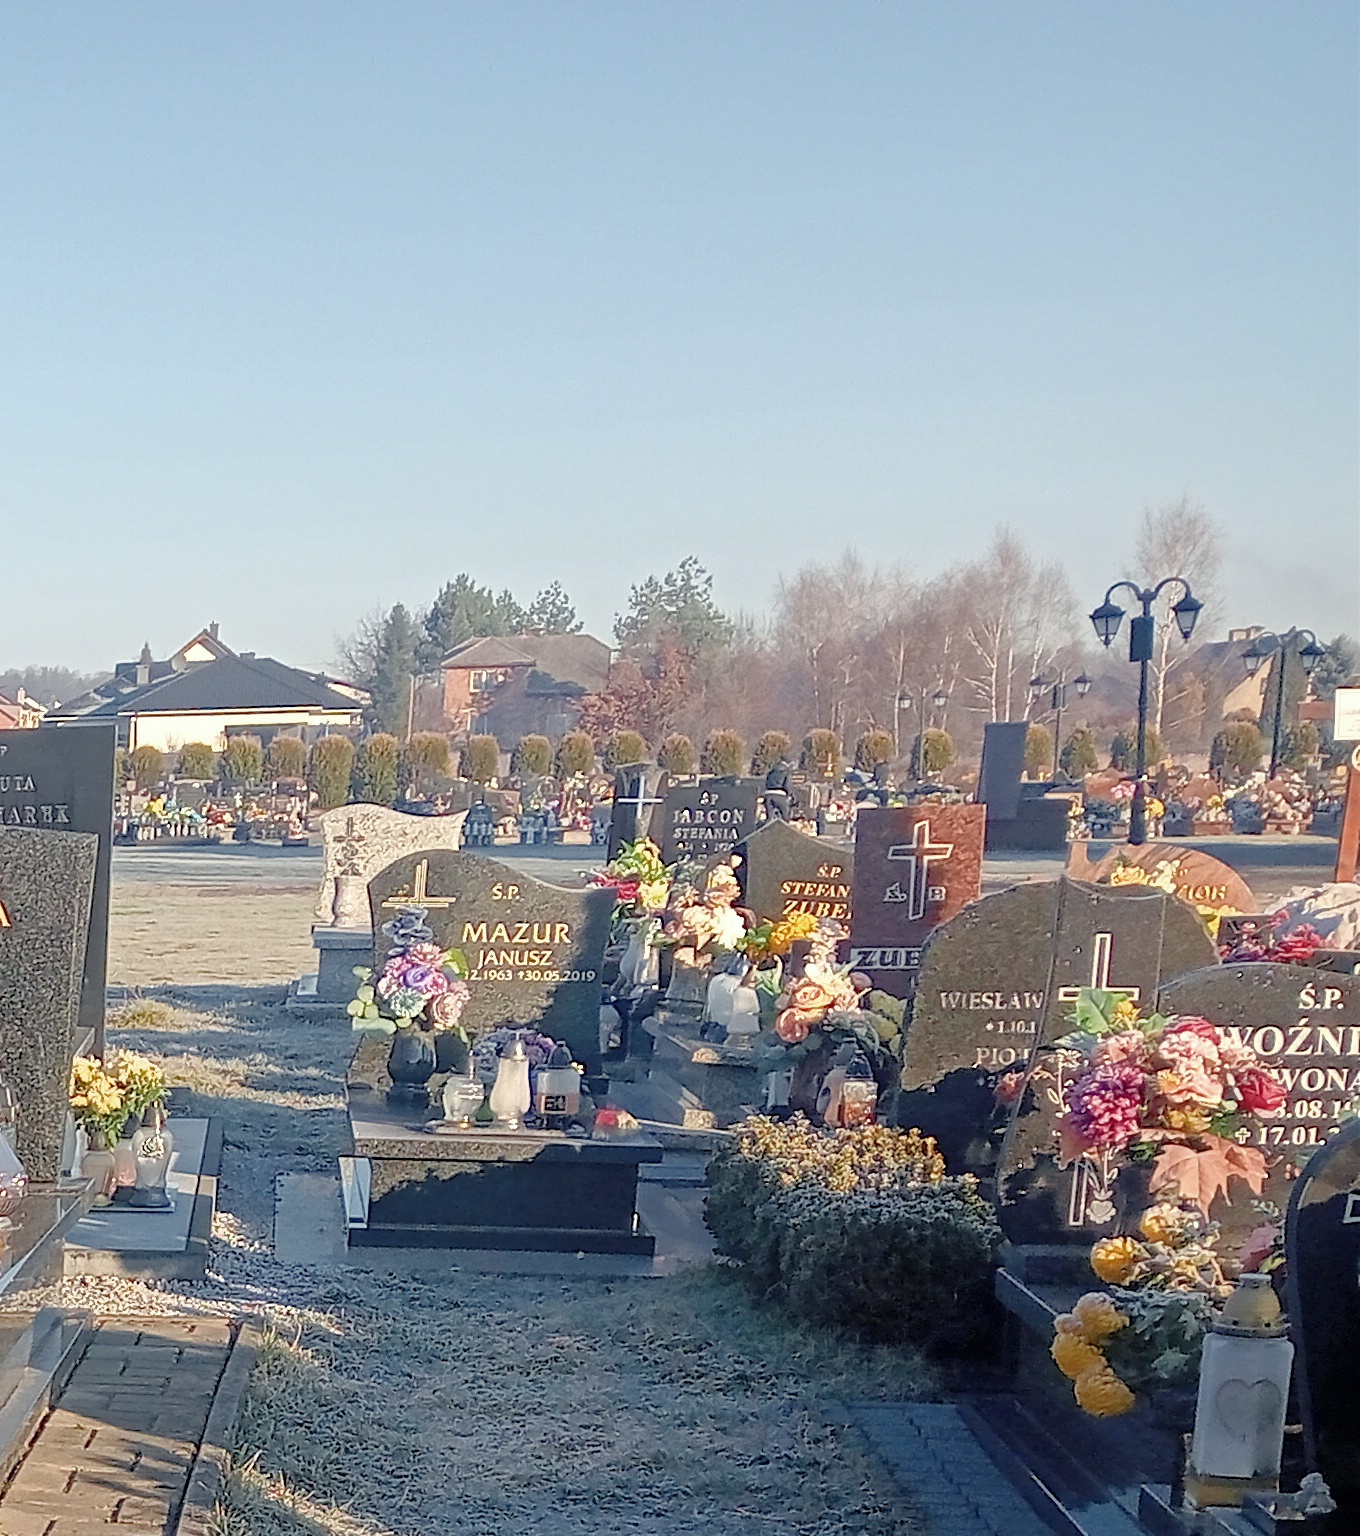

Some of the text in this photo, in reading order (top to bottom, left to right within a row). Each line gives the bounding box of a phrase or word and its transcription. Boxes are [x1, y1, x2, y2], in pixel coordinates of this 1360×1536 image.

[673, 826, 739, 840] STEFANIA
[491, 882, 521, 900] Ś.P.
[782, 899, 853, 920] ZUBE
[461, 921, 573, 944] MAZUR
[477, 949, 554, 970] JANUSZ
[939, 991, 1044, 1010] WIESŁAW
[1298, 981, 1345, 1010] Ś.P.
